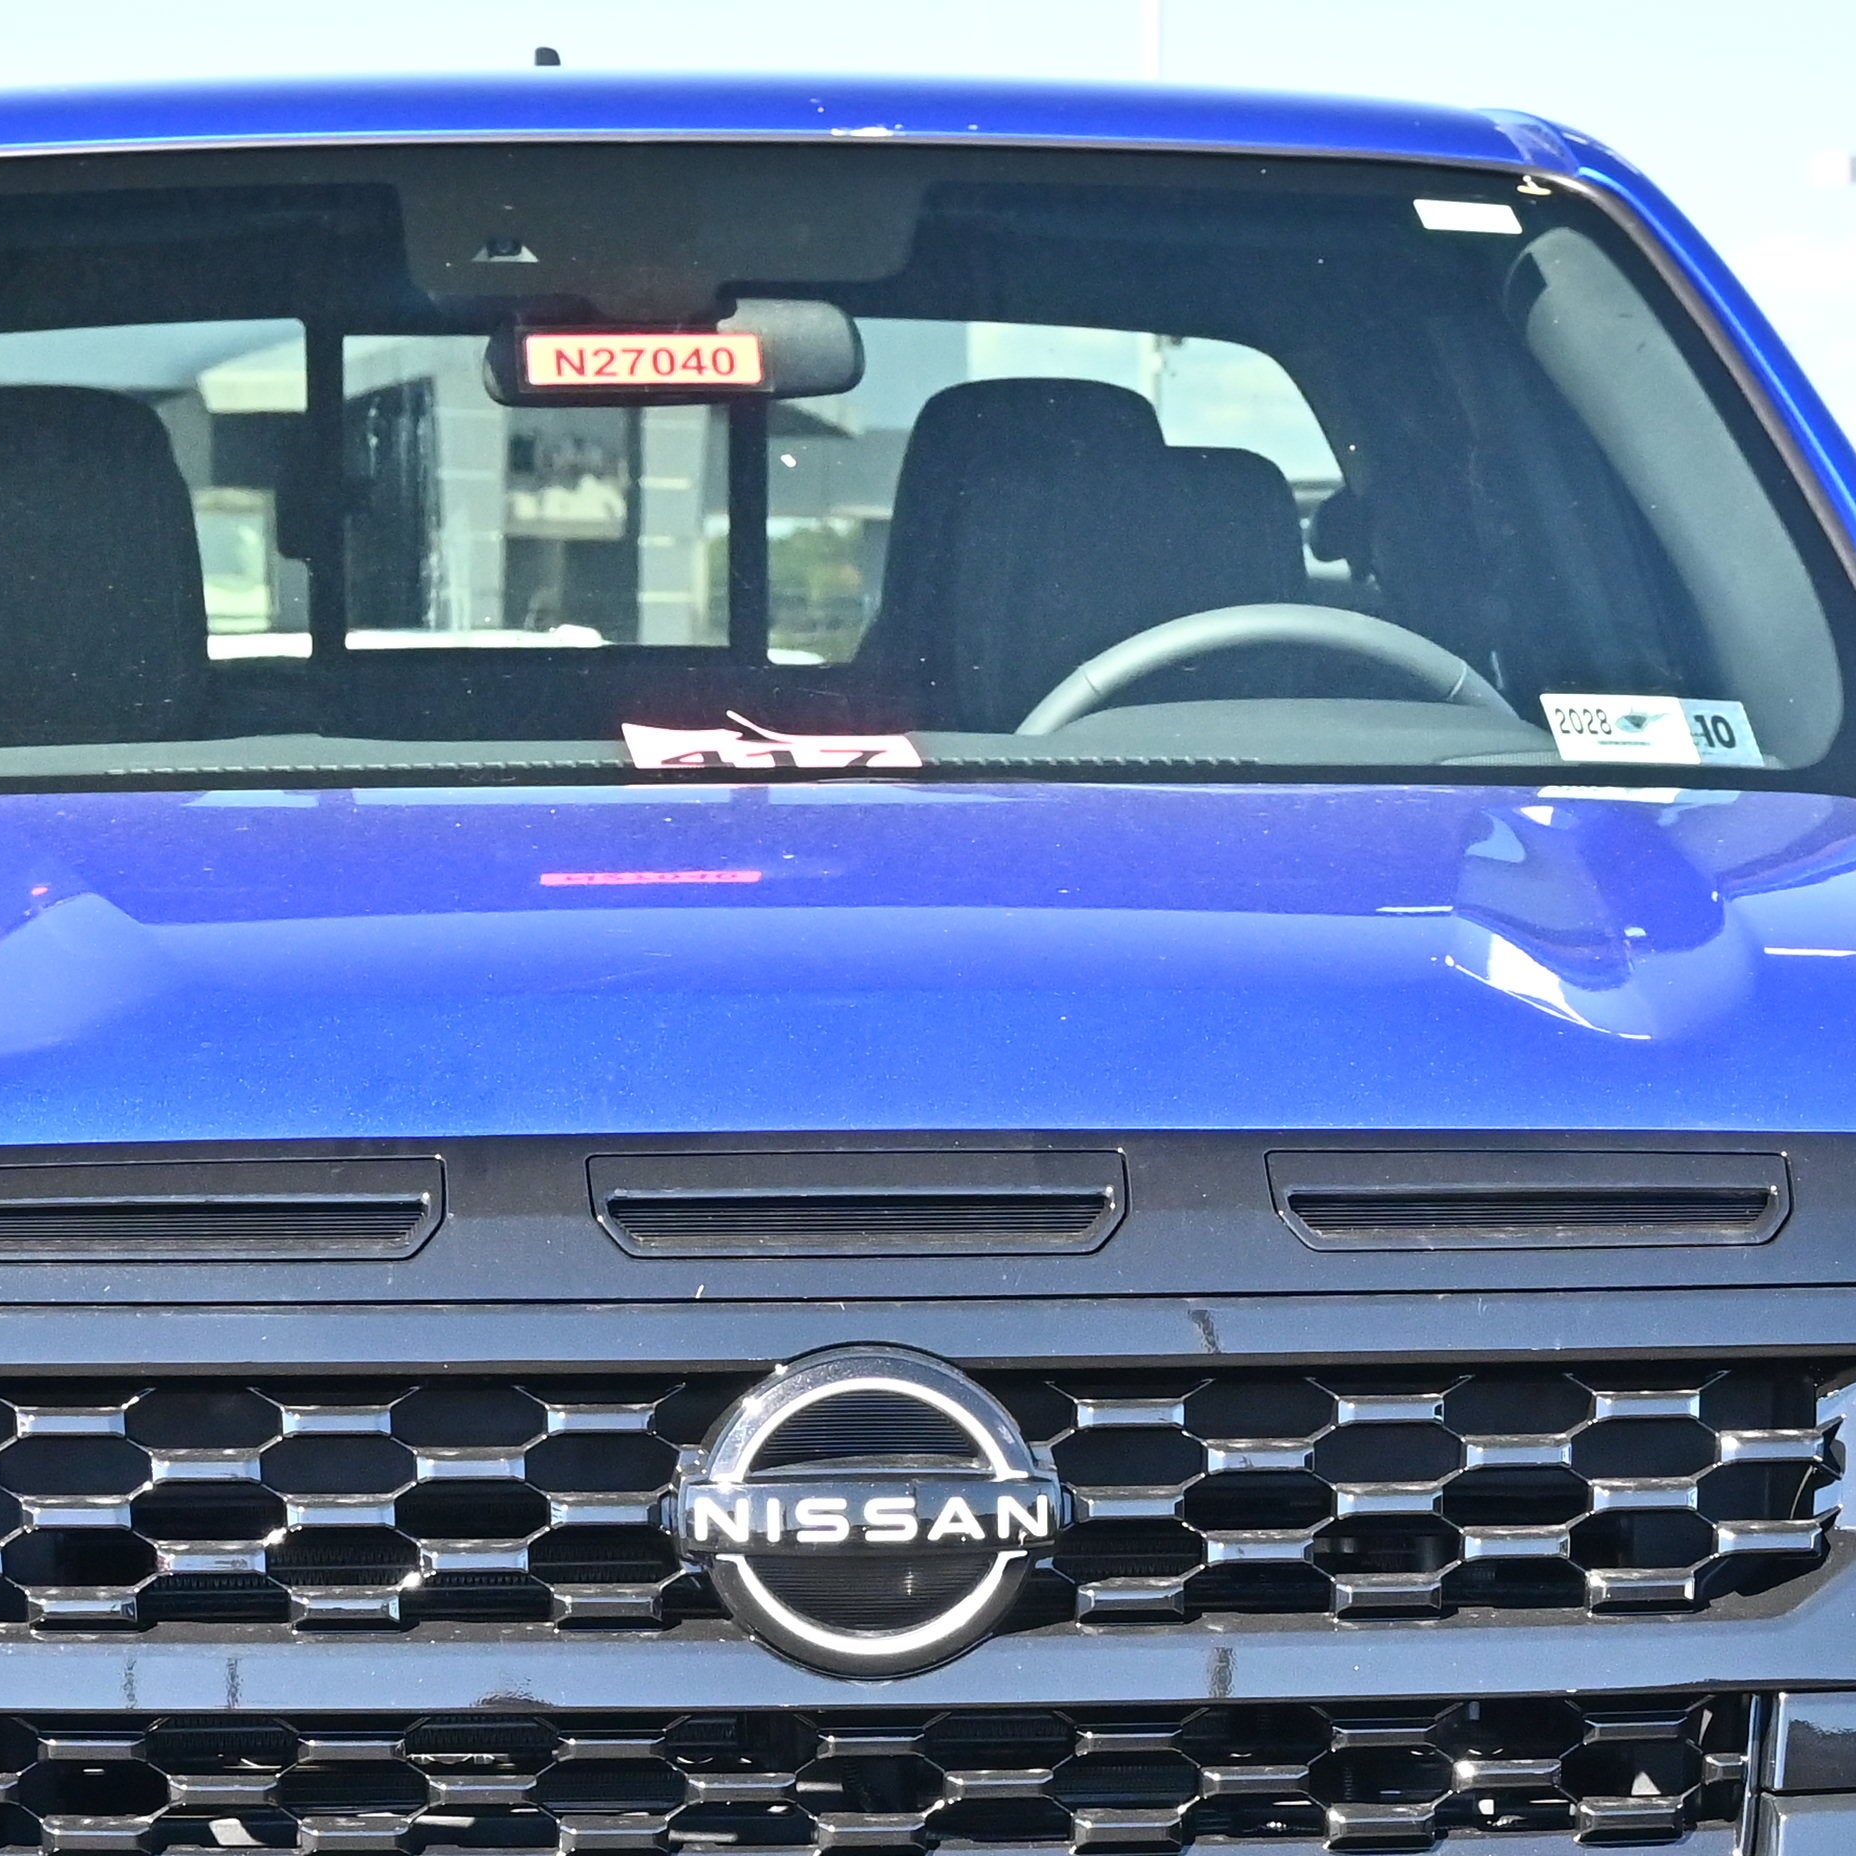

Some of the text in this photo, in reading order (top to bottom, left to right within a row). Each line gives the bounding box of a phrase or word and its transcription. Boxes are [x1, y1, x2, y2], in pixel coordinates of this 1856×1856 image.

[554, 346, 737, 378] N27040
[1554, 707, 1613, 736] 2028
[1693, 714, 1737, 749] 10
[691, 1494, 1050, 1544] NISSAN
